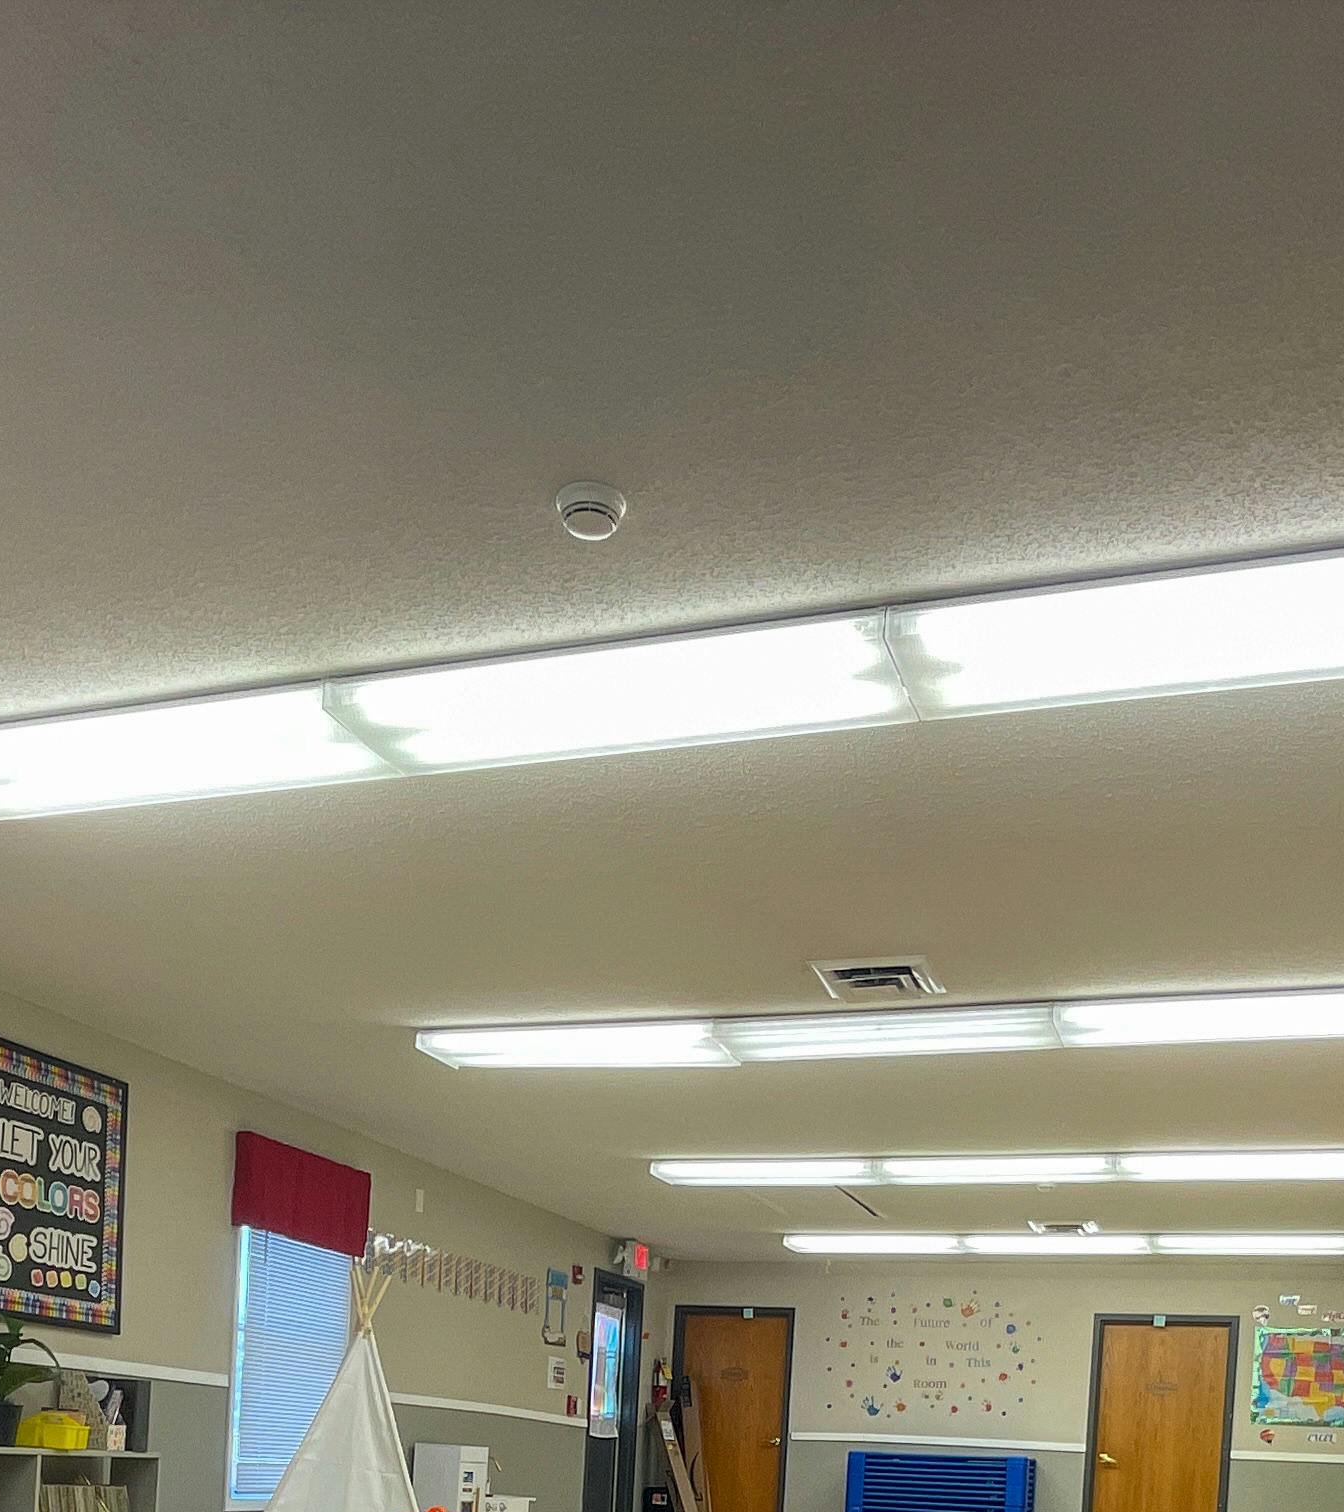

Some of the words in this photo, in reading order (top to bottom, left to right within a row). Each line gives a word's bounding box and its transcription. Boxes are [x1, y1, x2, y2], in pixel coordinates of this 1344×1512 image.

[49, 1133, 101, 1182] YOUR
[0, 1169, 101, 1223] COLORS
[29, 1227, 98, 1273] SHINE
[860, 1316, 880, 1327] The
[913, 1317, 951, 1329] Future
[886, 1338, 905, 1349] the
[945, 1340, 980, 1352] World
[966, 1356, 992, 1368] This
[913, 1379, 947, 1389] Room
